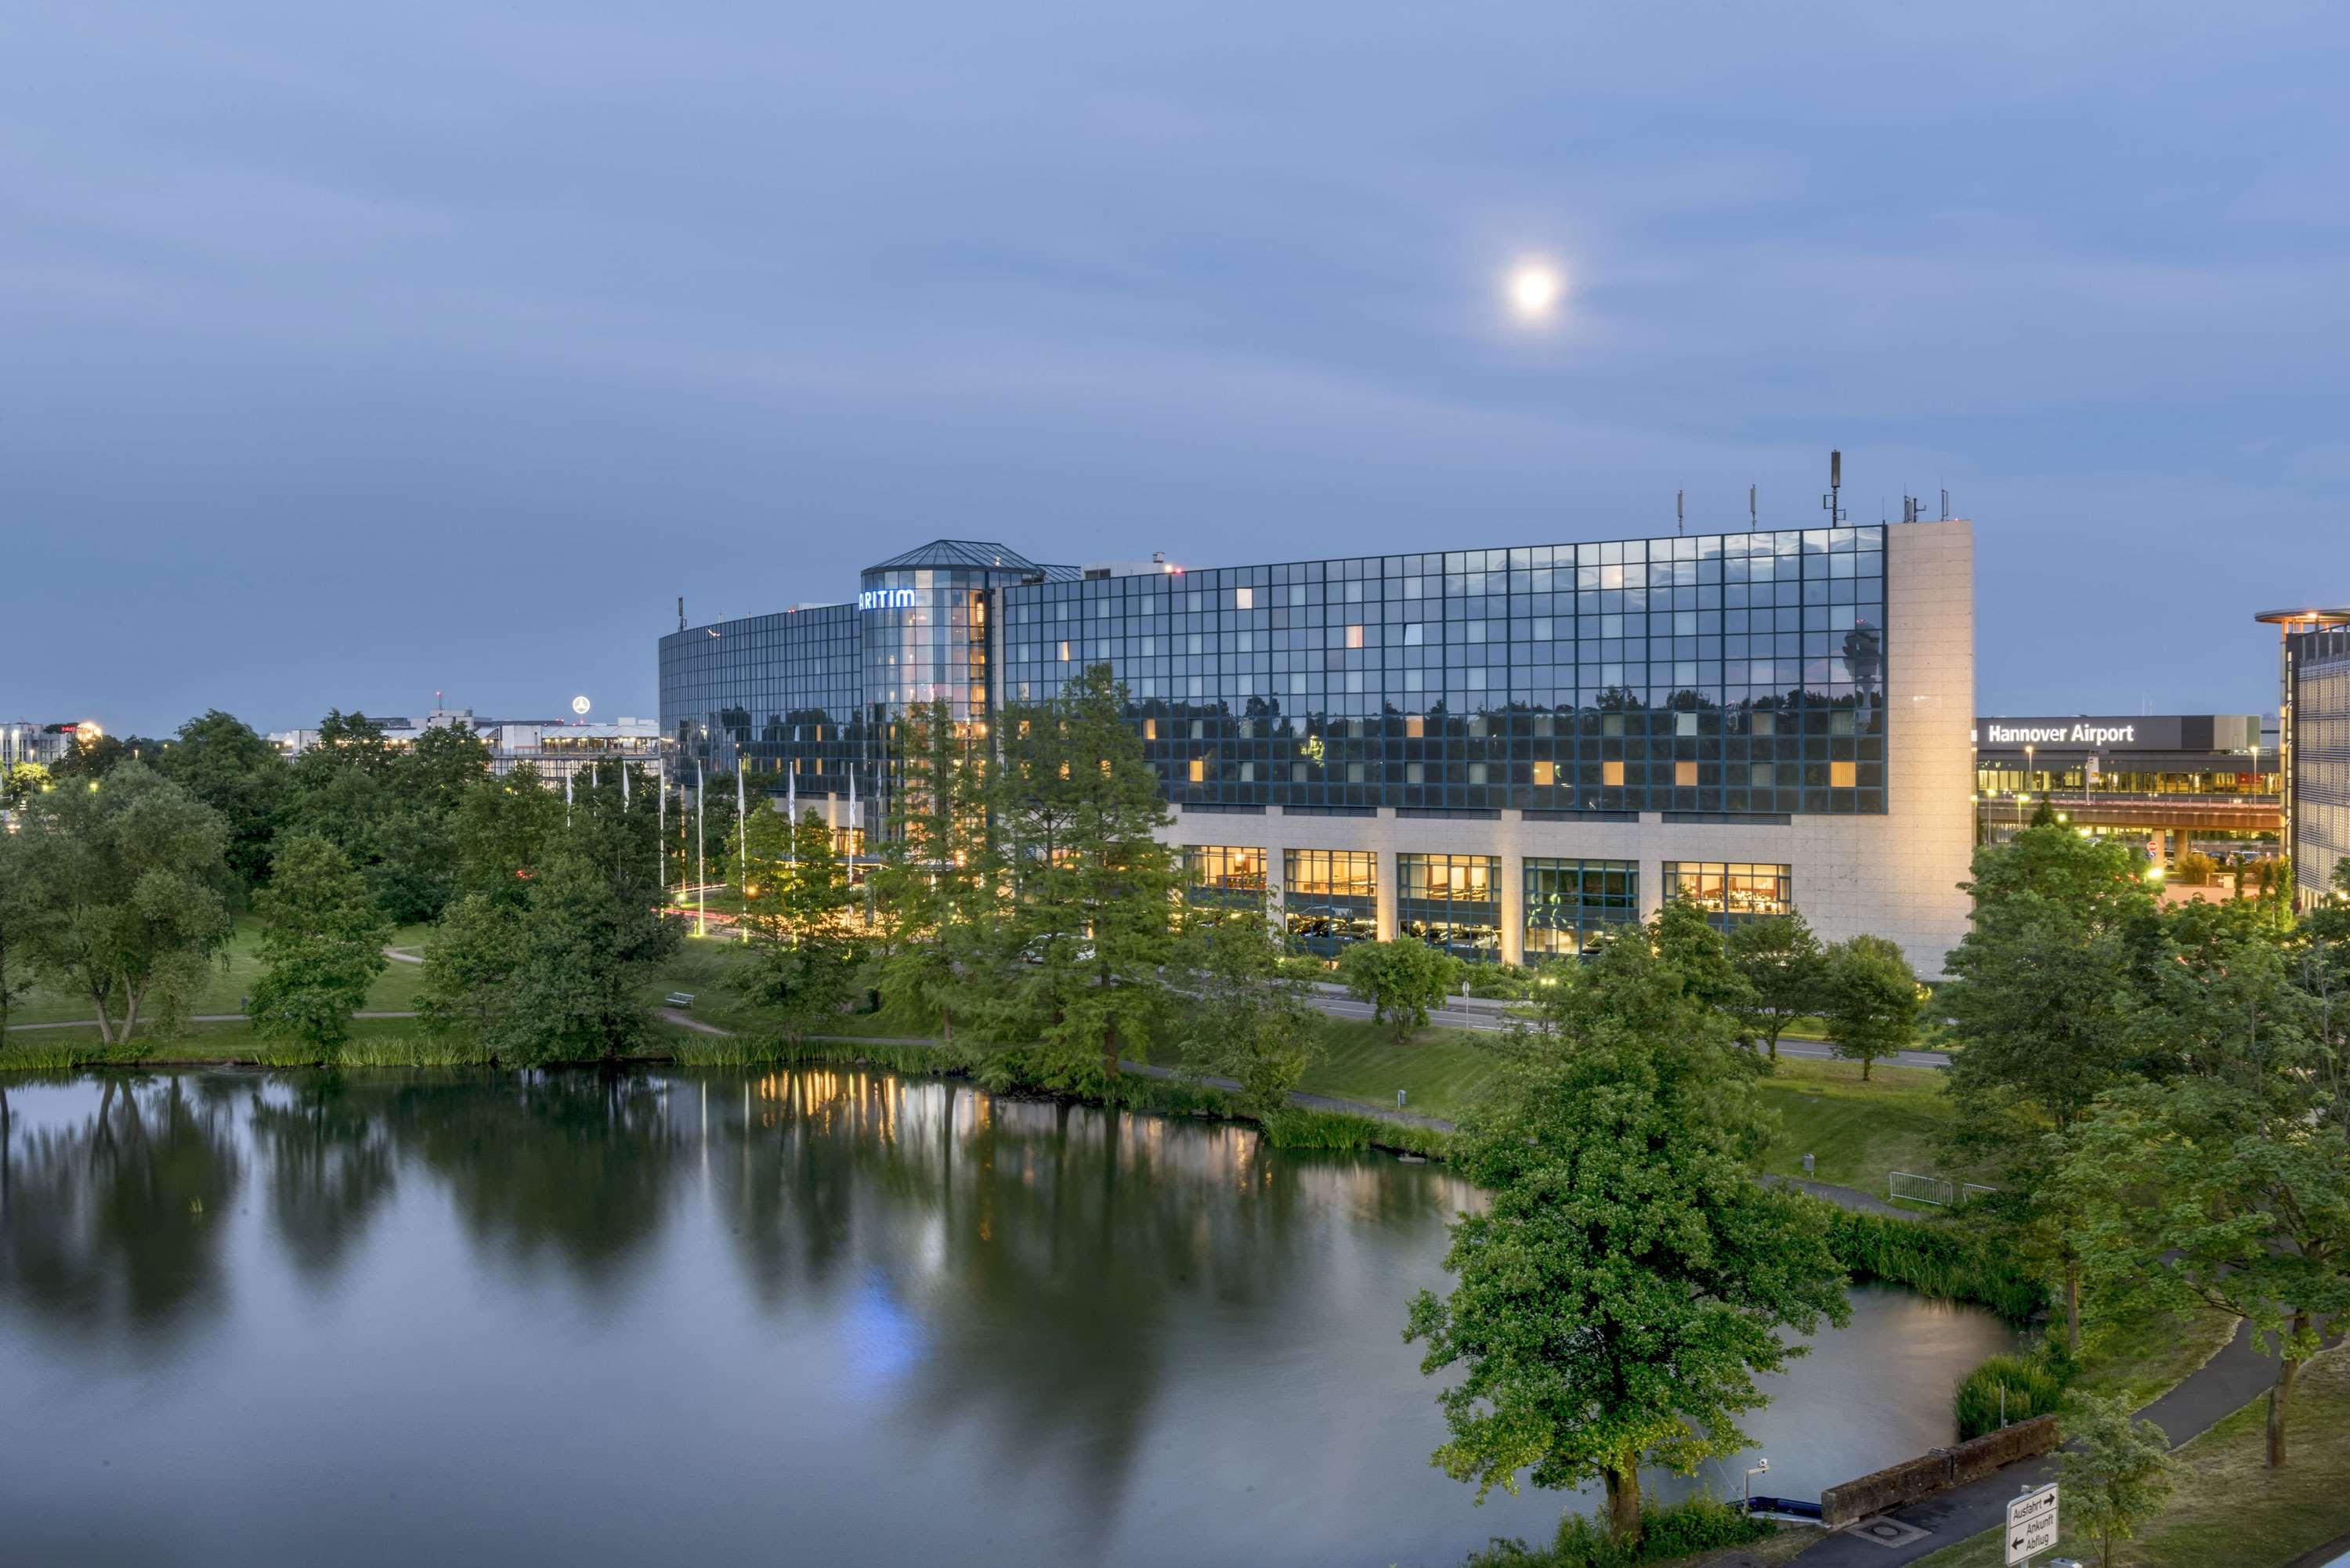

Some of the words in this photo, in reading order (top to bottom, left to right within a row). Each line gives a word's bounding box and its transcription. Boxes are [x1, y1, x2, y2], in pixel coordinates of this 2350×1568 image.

[1989, 725, 2067, 742] Hannover
[2070, 724, 2134, 746] Airport
[2013, 1498, 2042, 1521] Ausfahrt
[2026, 1515, 2053, 1535] Ankunft
[2026, 1534, 2049, 1551] Abflug
